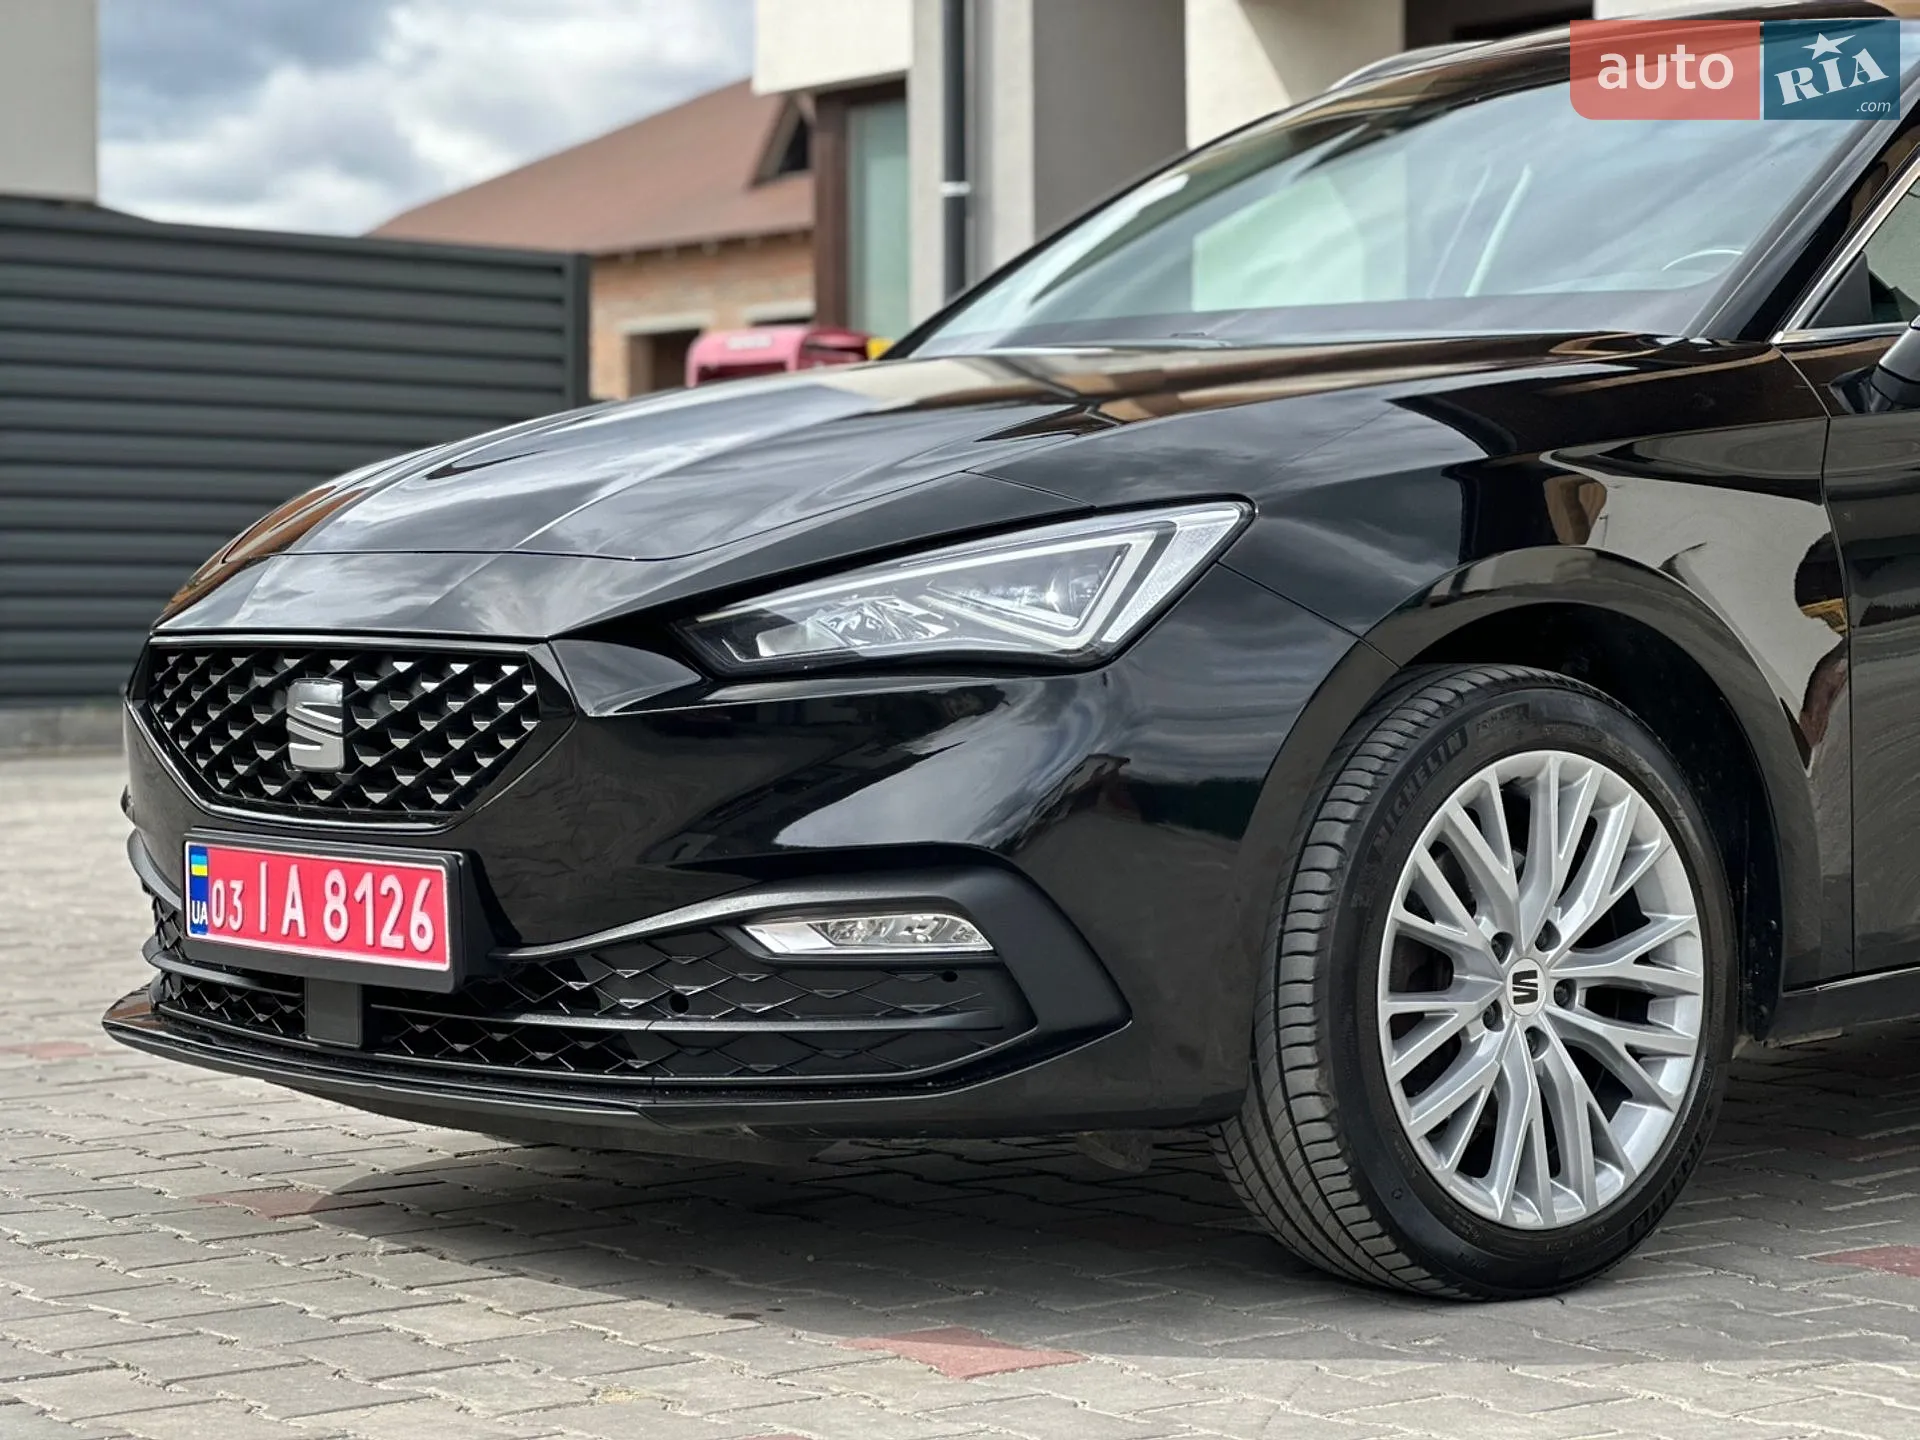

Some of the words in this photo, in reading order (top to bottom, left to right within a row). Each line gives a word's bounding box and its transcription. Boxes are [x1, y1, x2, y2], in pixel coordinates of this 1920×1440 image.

[191, 900, 208, 926] UA
[211, 879, 245, 931] 03
[322, 868, 436, 953] 8126
